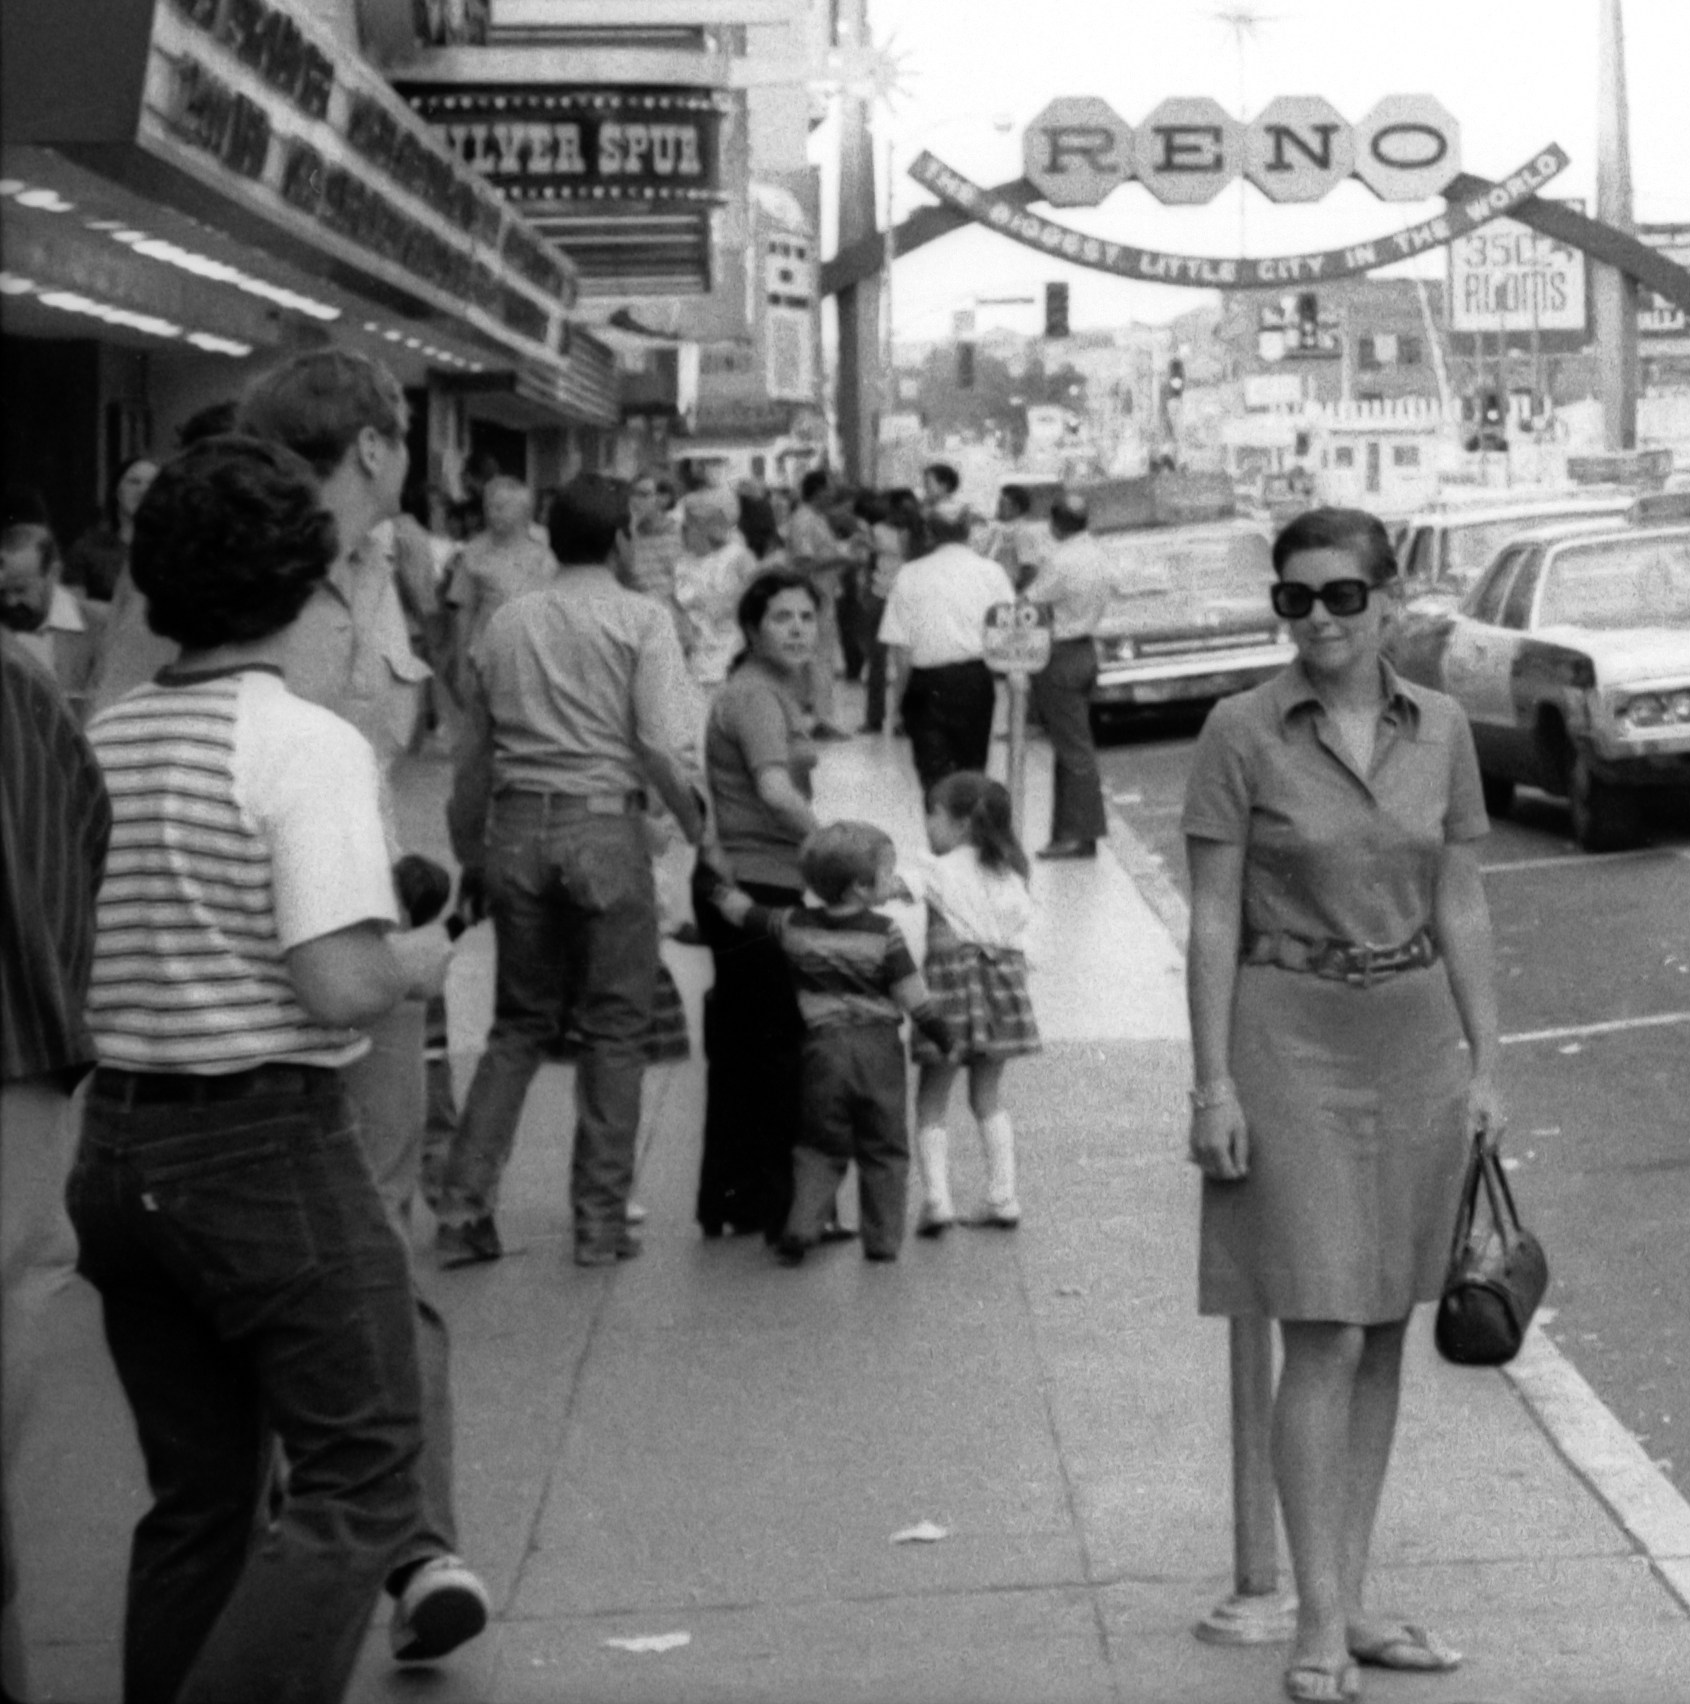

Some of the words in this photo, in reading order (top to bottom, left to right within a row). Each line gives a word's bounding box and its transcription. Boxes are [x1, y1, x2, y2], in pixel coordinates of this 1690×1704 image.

[428, 122, 585, 174] ILVER
[1041, 122, 1448, 174] RENO
[924, 160, 978, 202] THE
[988, 202, 1121, 266] BIGGEST
[1139, 253, 1236, 283] LITTLE
[1257, 255, 1325, 281] CITY
[1345, 246, 1376, 269] IN
[1393, 217, 1451, 254] THE
[1465, 152, 1560, 222] WORLD
